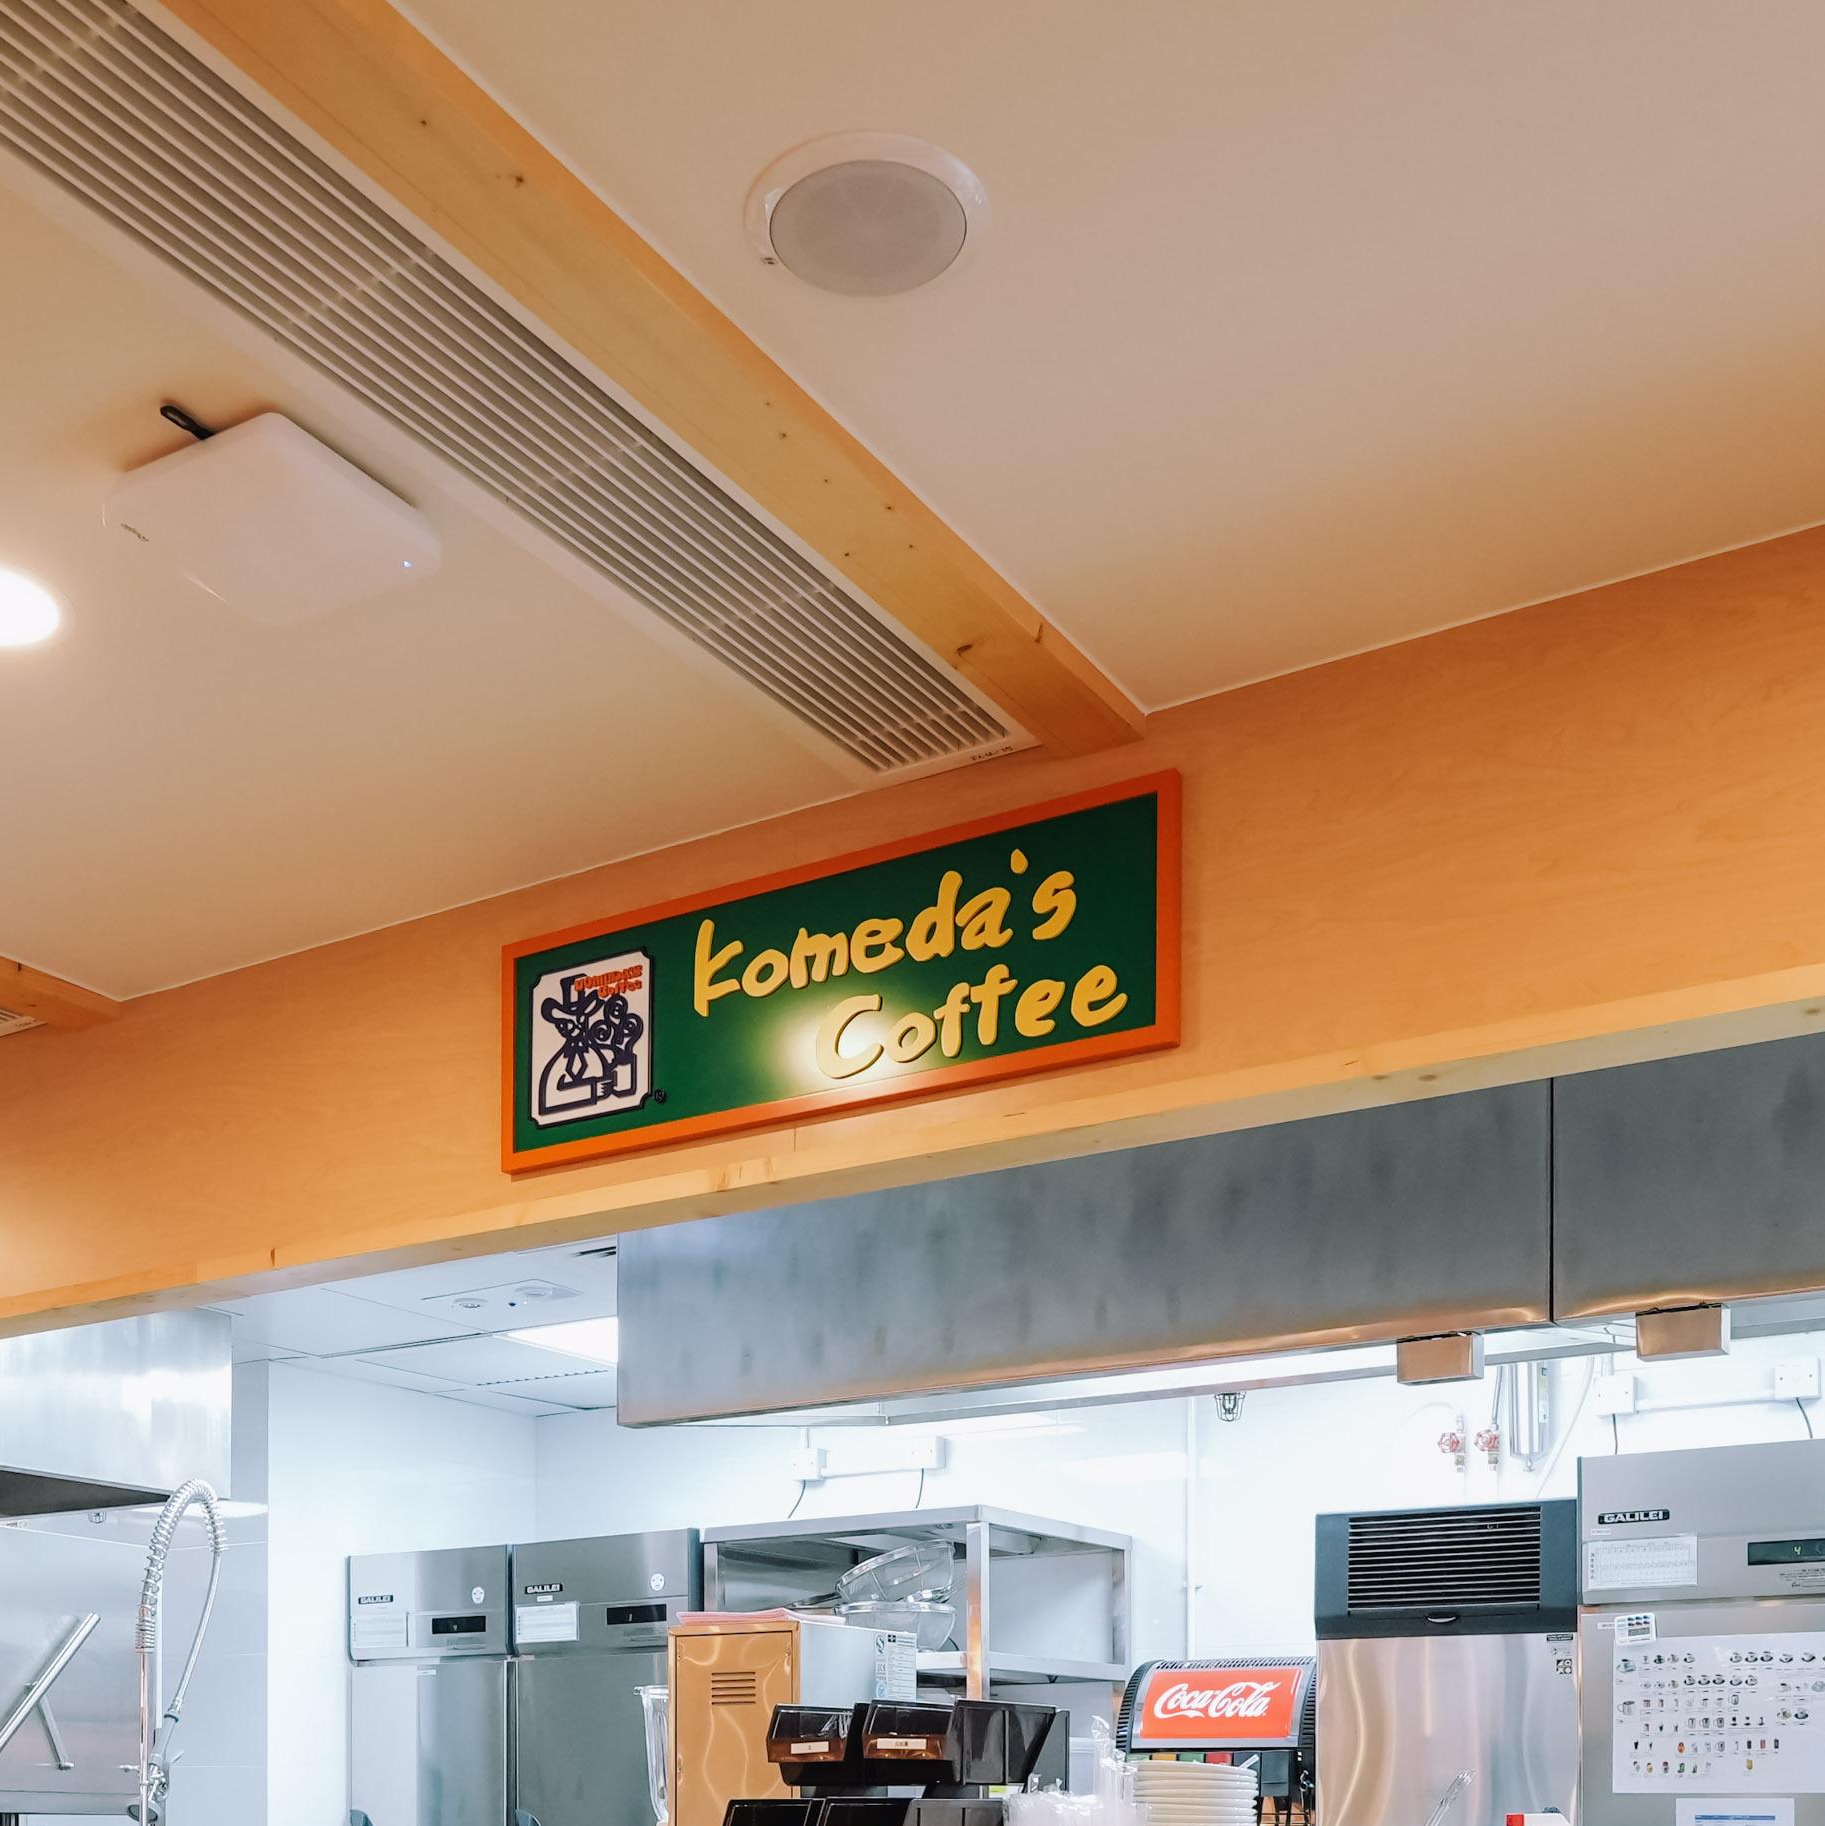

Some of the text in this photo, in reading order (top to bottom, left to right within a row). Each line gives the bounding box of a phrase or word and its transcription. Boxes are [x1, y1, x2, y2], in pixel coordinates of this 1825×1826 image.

[815, 964, 1128, 1080] Coffee
[1603, 1510, 1664, 1524] GALILEI
[525, 1583, 561, 1595] GALILEI
[1154, 1682, 1282, 1719] Coca-Cola
